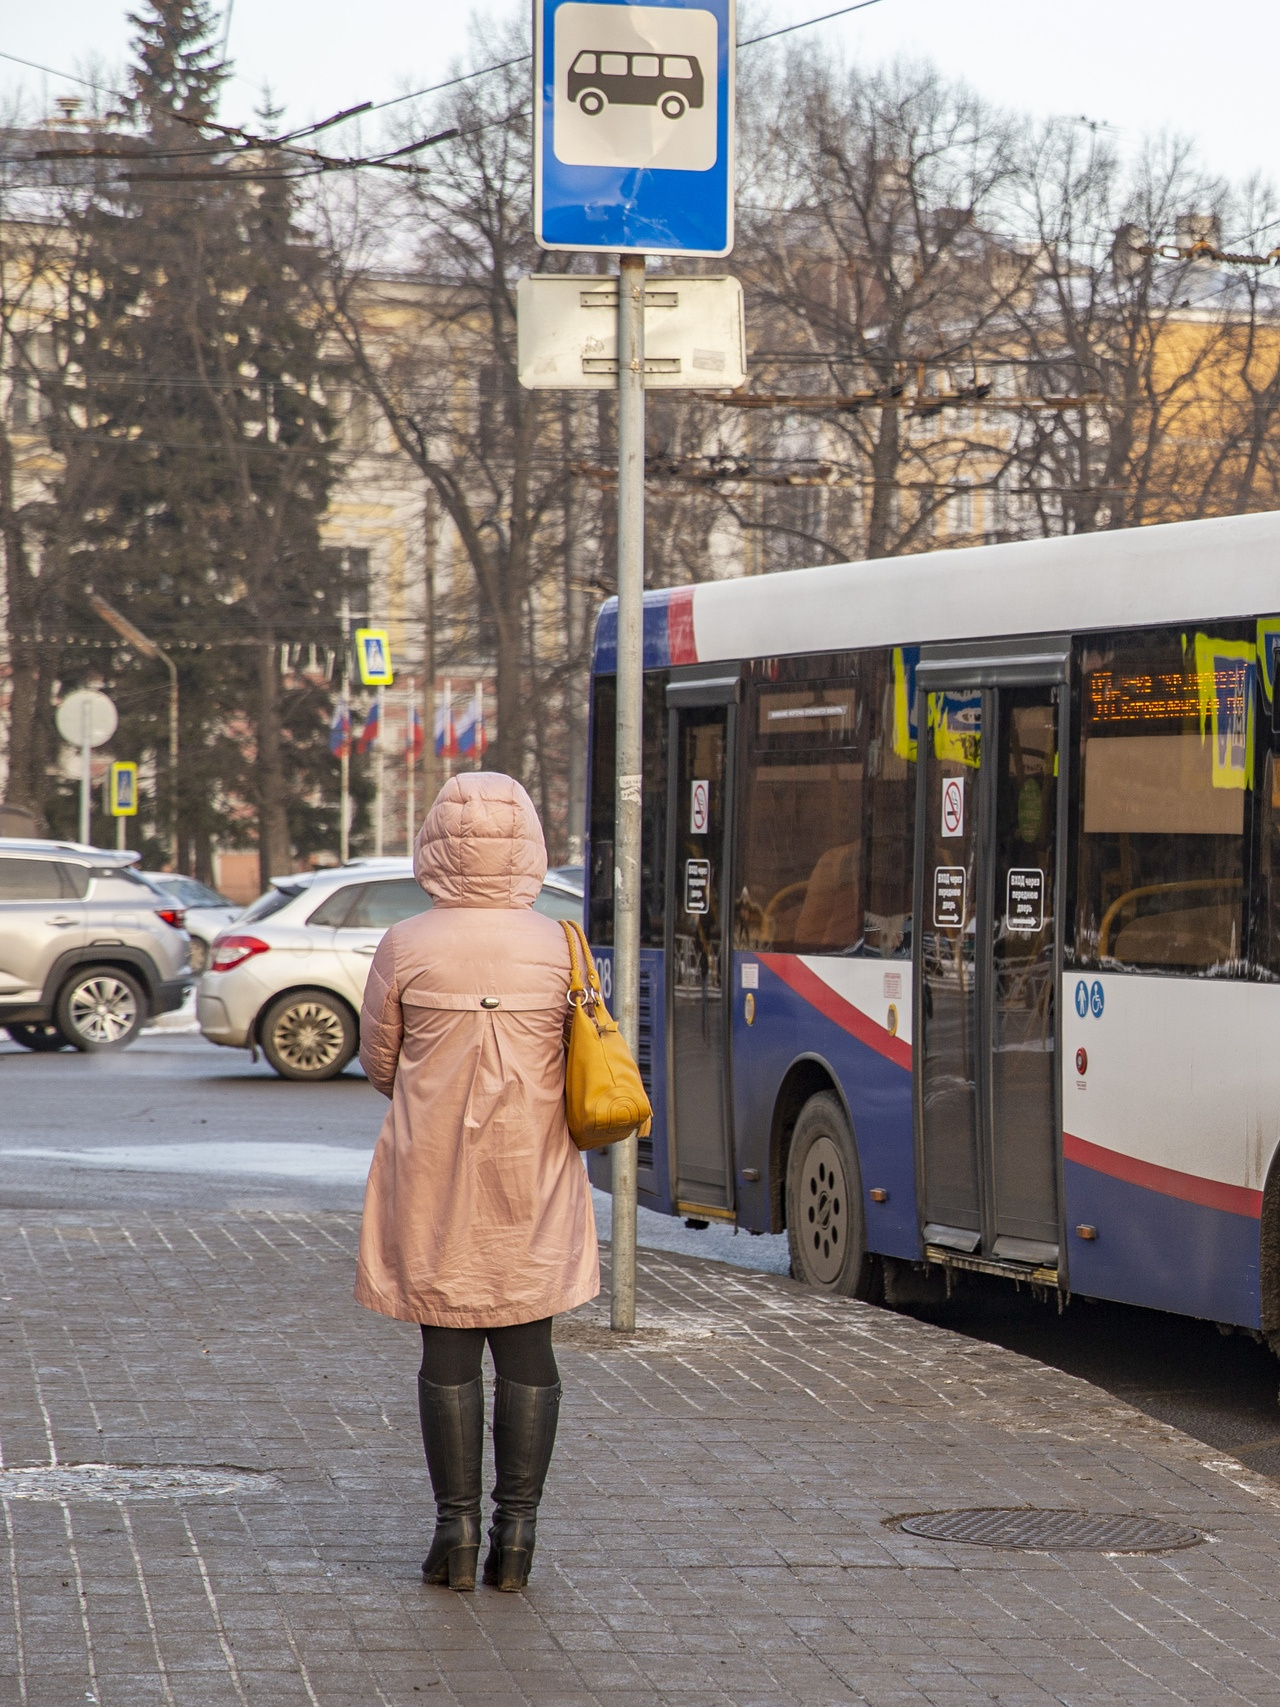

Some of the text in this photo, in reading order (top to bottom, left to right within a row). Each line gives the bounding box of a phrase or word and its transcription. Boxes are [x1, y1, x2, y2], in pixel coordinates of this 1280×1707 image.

[937, 873, 950, 884] ВХОД
[1011, 875, 1040, 888] ВХОД через
[1016, 904, 1032, 914] дверь
